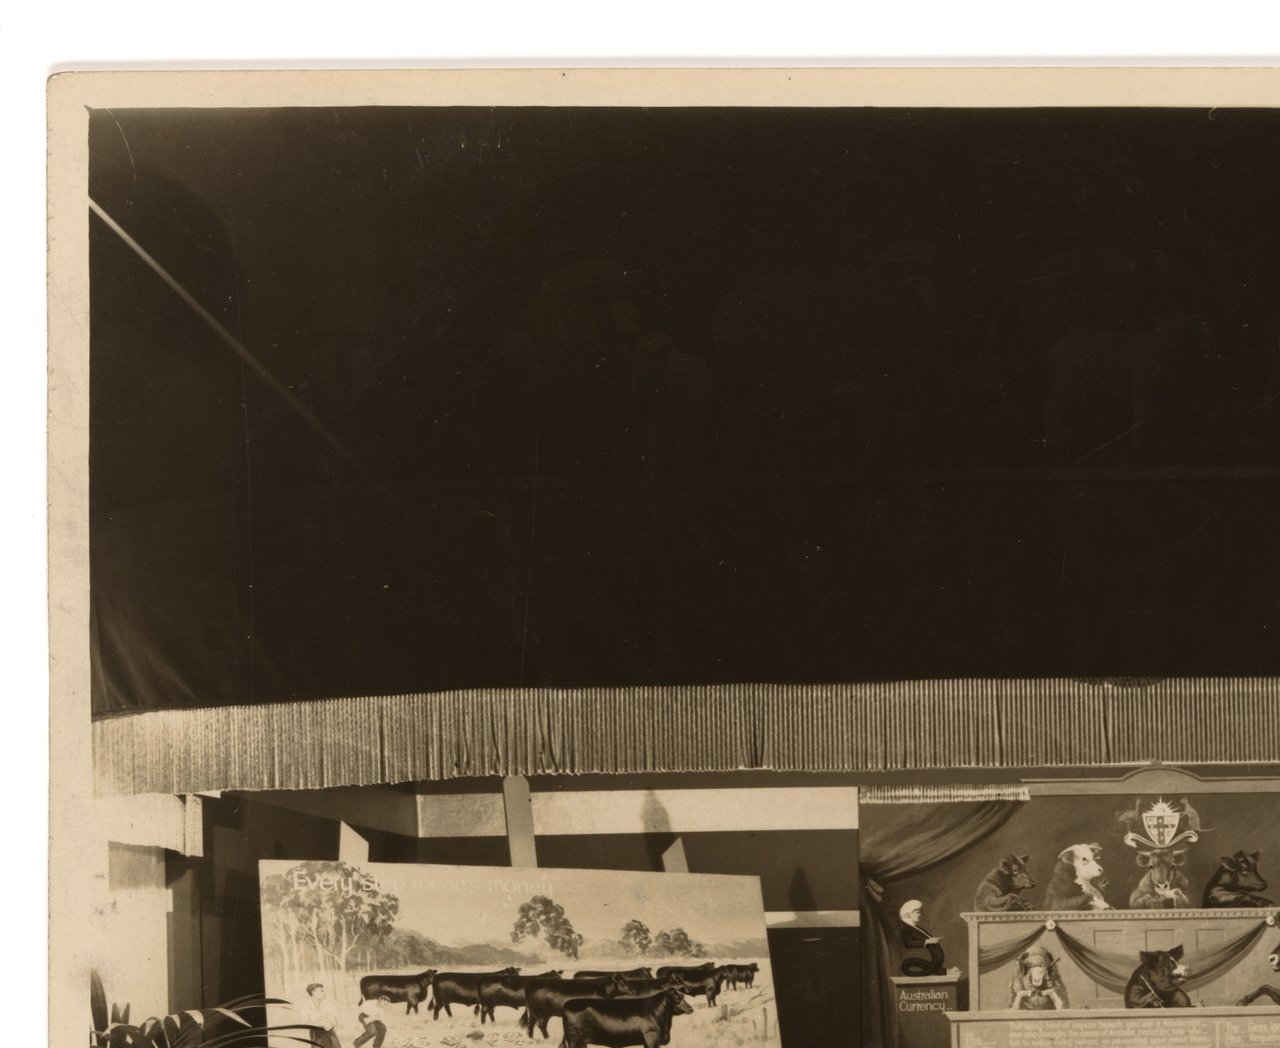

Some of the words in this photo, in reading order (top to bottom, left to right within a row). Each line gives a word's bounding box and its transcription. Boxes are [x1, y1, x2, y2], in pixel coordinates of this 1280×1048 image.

[293, 870, 353, 897] Every
[363, 876, 404, 894] sp
[487, 877, 554, 895] money
[900, 990, 948, 1000] Australian
